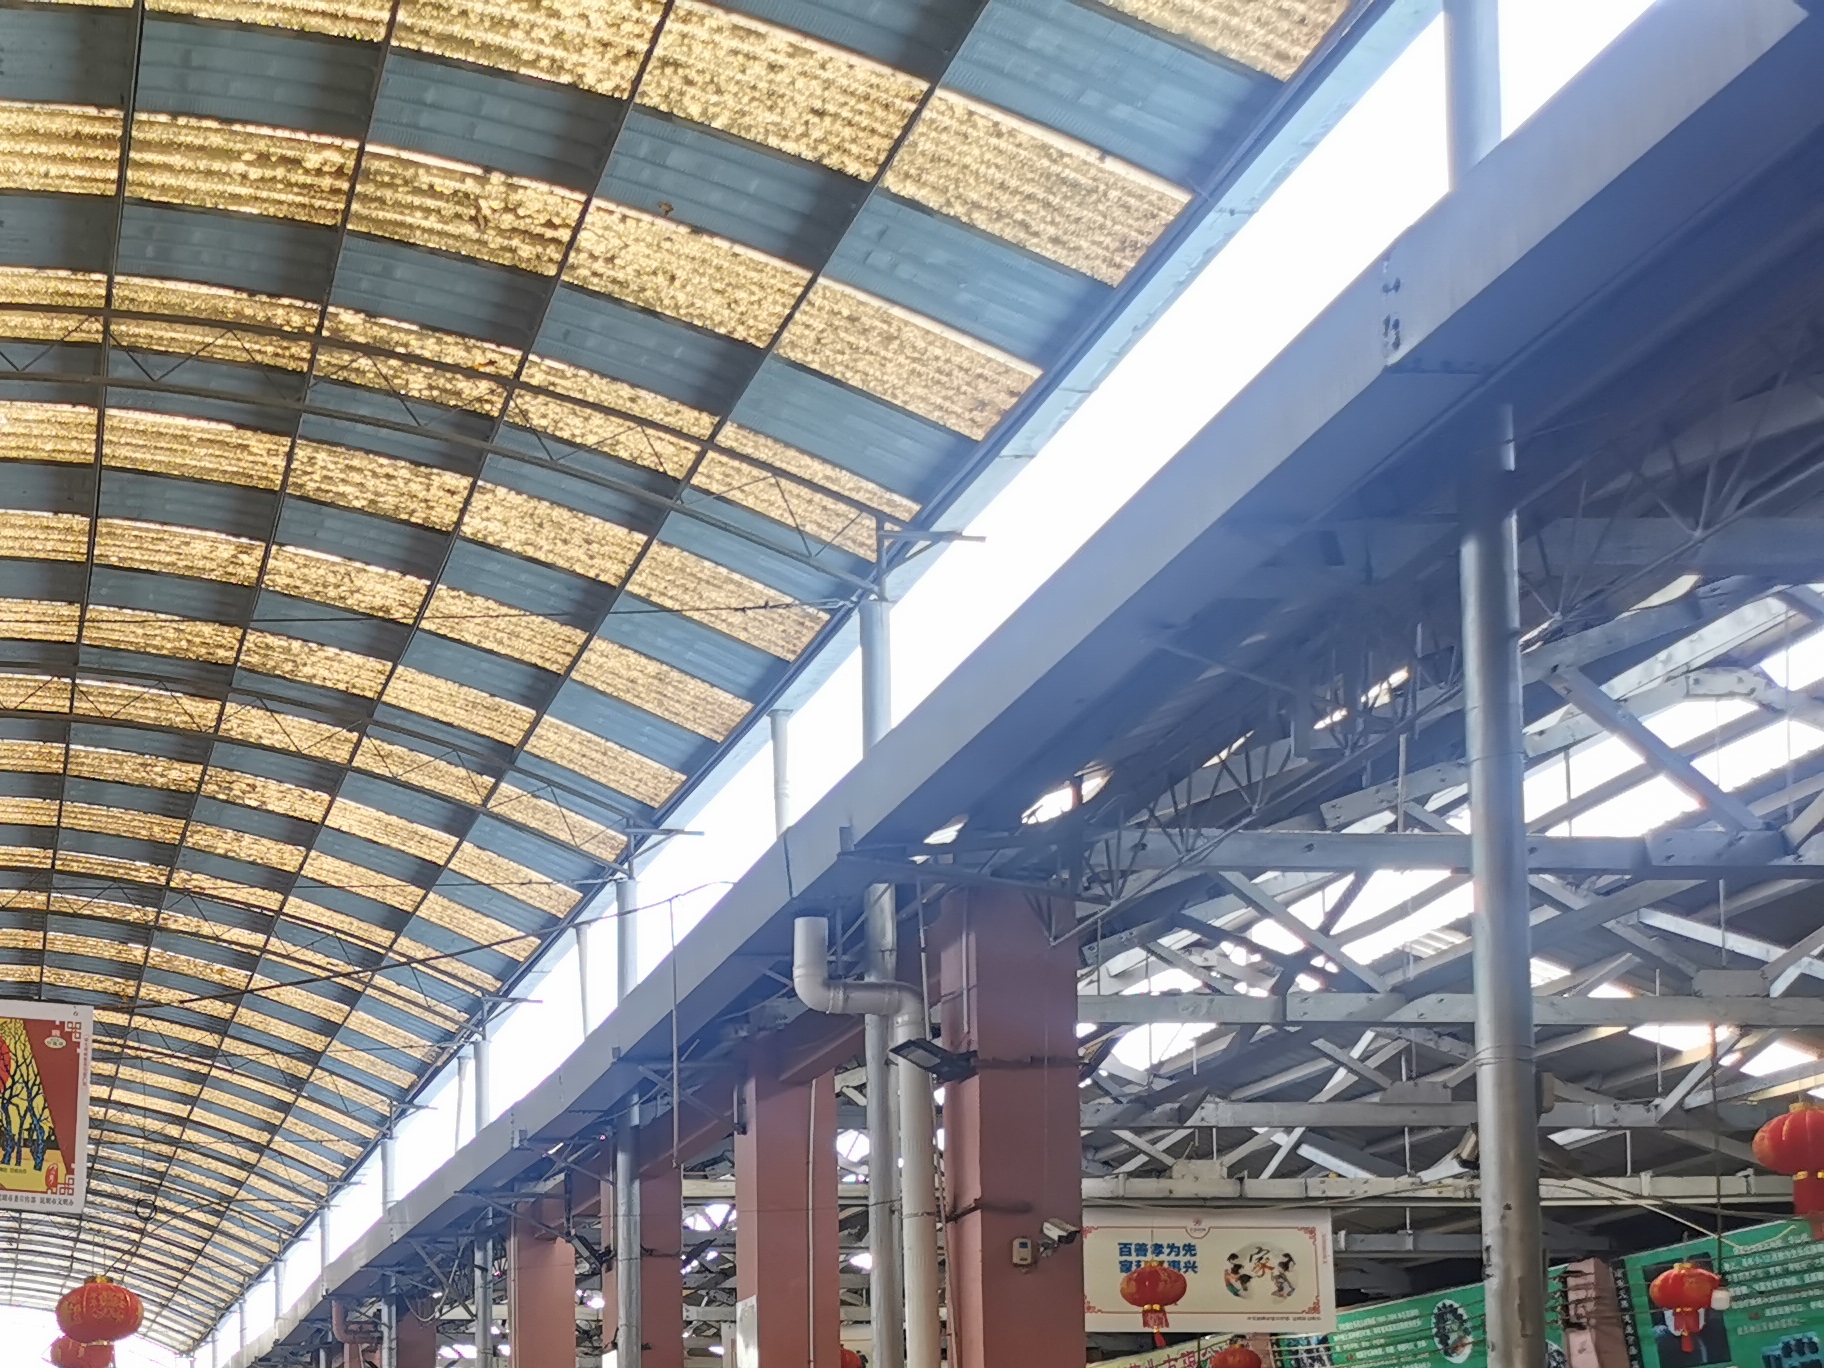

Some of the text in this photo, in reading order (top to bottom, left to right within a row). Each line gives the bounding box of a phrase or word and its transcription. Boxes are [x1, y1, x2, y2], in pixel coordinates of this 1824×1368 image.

[1118, 1242, 1198, 1258] 百善孝为先
